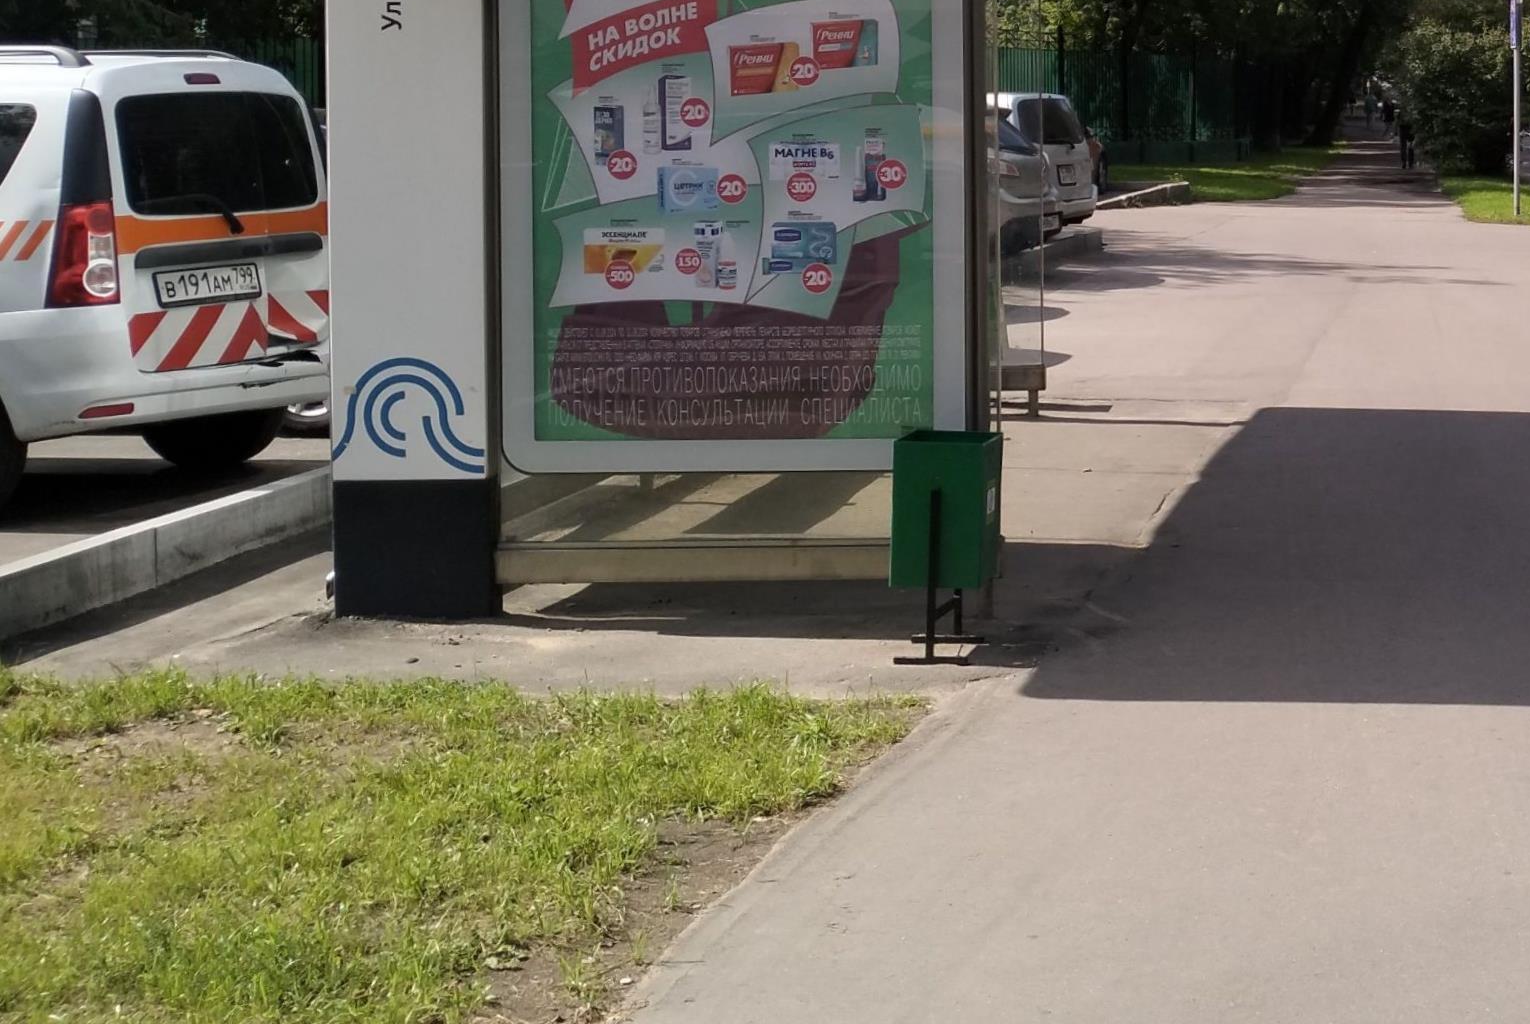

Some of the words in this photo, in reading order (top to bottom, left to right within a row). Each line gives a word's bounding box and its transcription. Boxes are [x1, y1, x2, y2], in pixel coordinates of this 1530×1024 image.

[588, 26, 620, 51] НА
[624, 2, 698, 36] ВОЛНЕ
[589, 27, 681, 72] СКИДОК
[774, 147, 817, 159] МАГНЕ
[547, 367, 625, 394] ИМЕЮТСЯ
[630, 365, 806, 394] ПРОТИВОПОКАЗАНИЯ.
[809, 364, 922, 393] НЕОБХОДИМО
[549, 399, 647, 426] ПОЛУЧЕНИЕ
[656, 397, 790, 428] КОНСУЛЬТАЦИИ
[801, 396, 922, 425] СПЕЦИАЛИСТА
